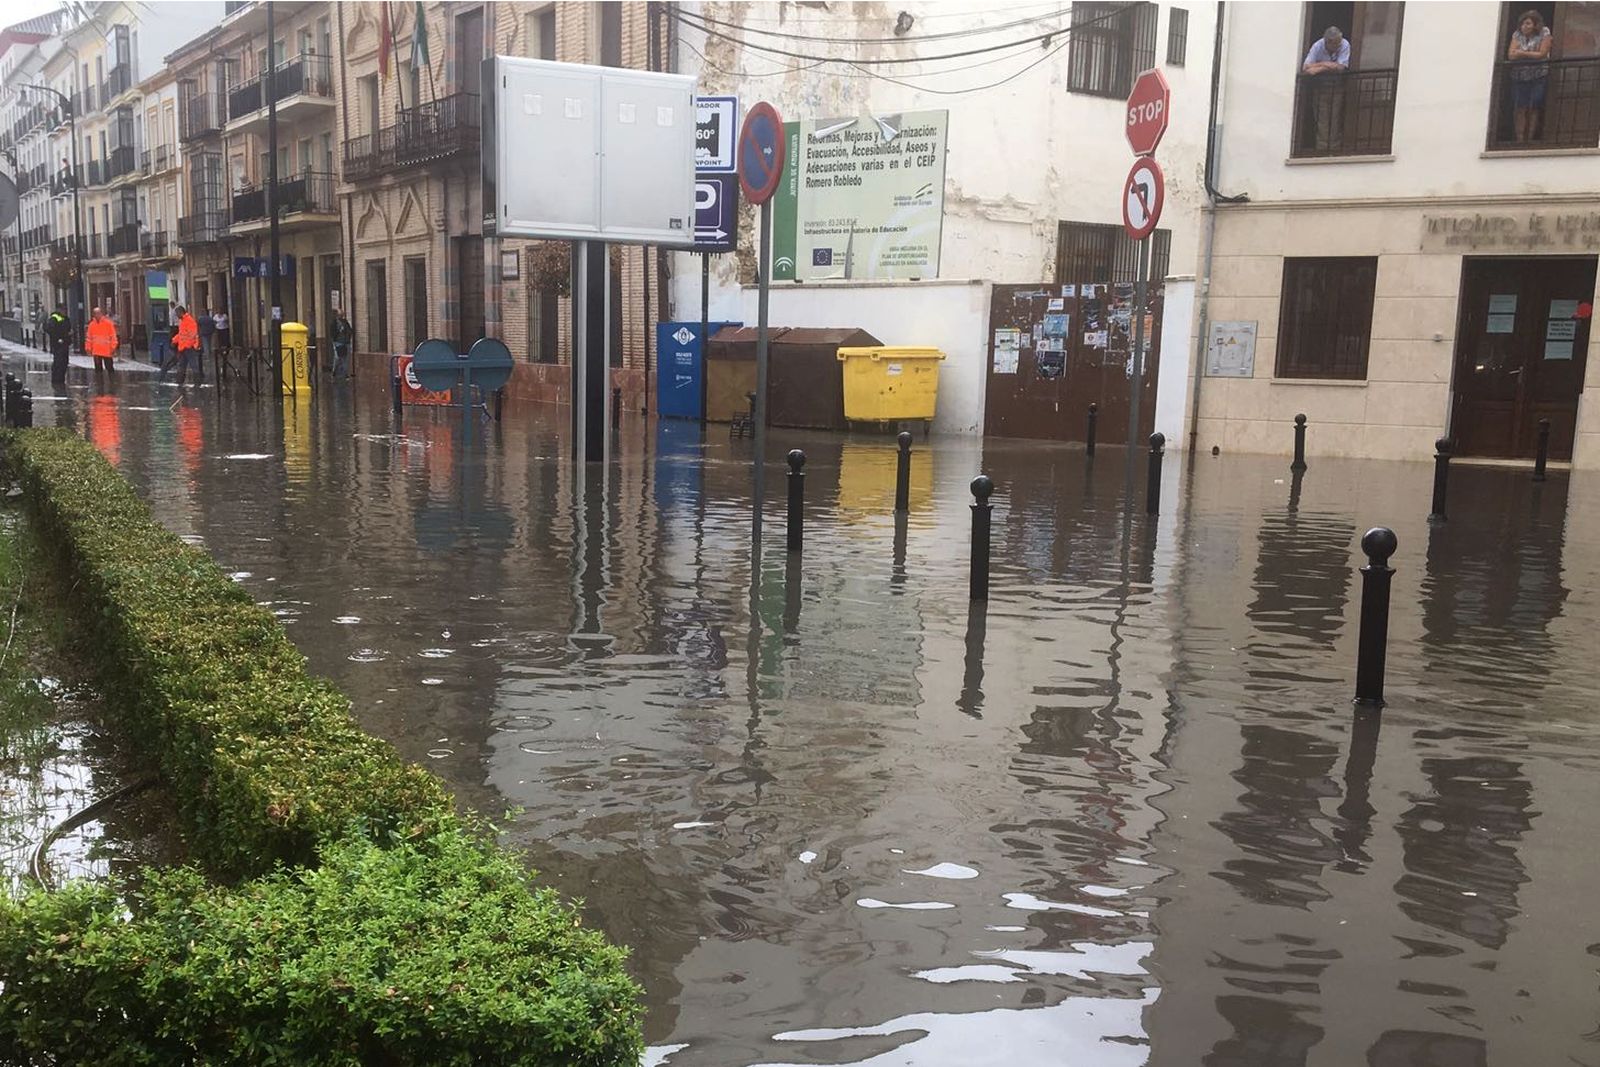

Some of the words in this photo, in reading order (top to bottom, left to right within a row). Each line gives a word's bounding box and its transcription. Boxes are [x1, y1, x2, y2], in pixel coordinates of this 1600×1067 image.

[1128, 99, 1163, 126] STOP
[844, 130, 872, 144] Mejoras
[874, 132, 879, 141] y
[882, 125, 937, 140] rnización:
[806, 147, 849, 159] Evacuación,
[851, 143, 903, 157] Accesibilidad,
[905, 141, 928, 153] Aseos
[931, 142, 936, 154] y
[806, 161, 856, 174] Adecuaciones
[861, 159, 884, 171] varias
[889, 159, 899, 169] en
[904, 156, 911, 168] el
[916, 155, 936, 167] CEIP
[805, 176, 832, 188] Romero
[833, 174, 862, 187] Robledo
[695, 183, 717, 209] P
